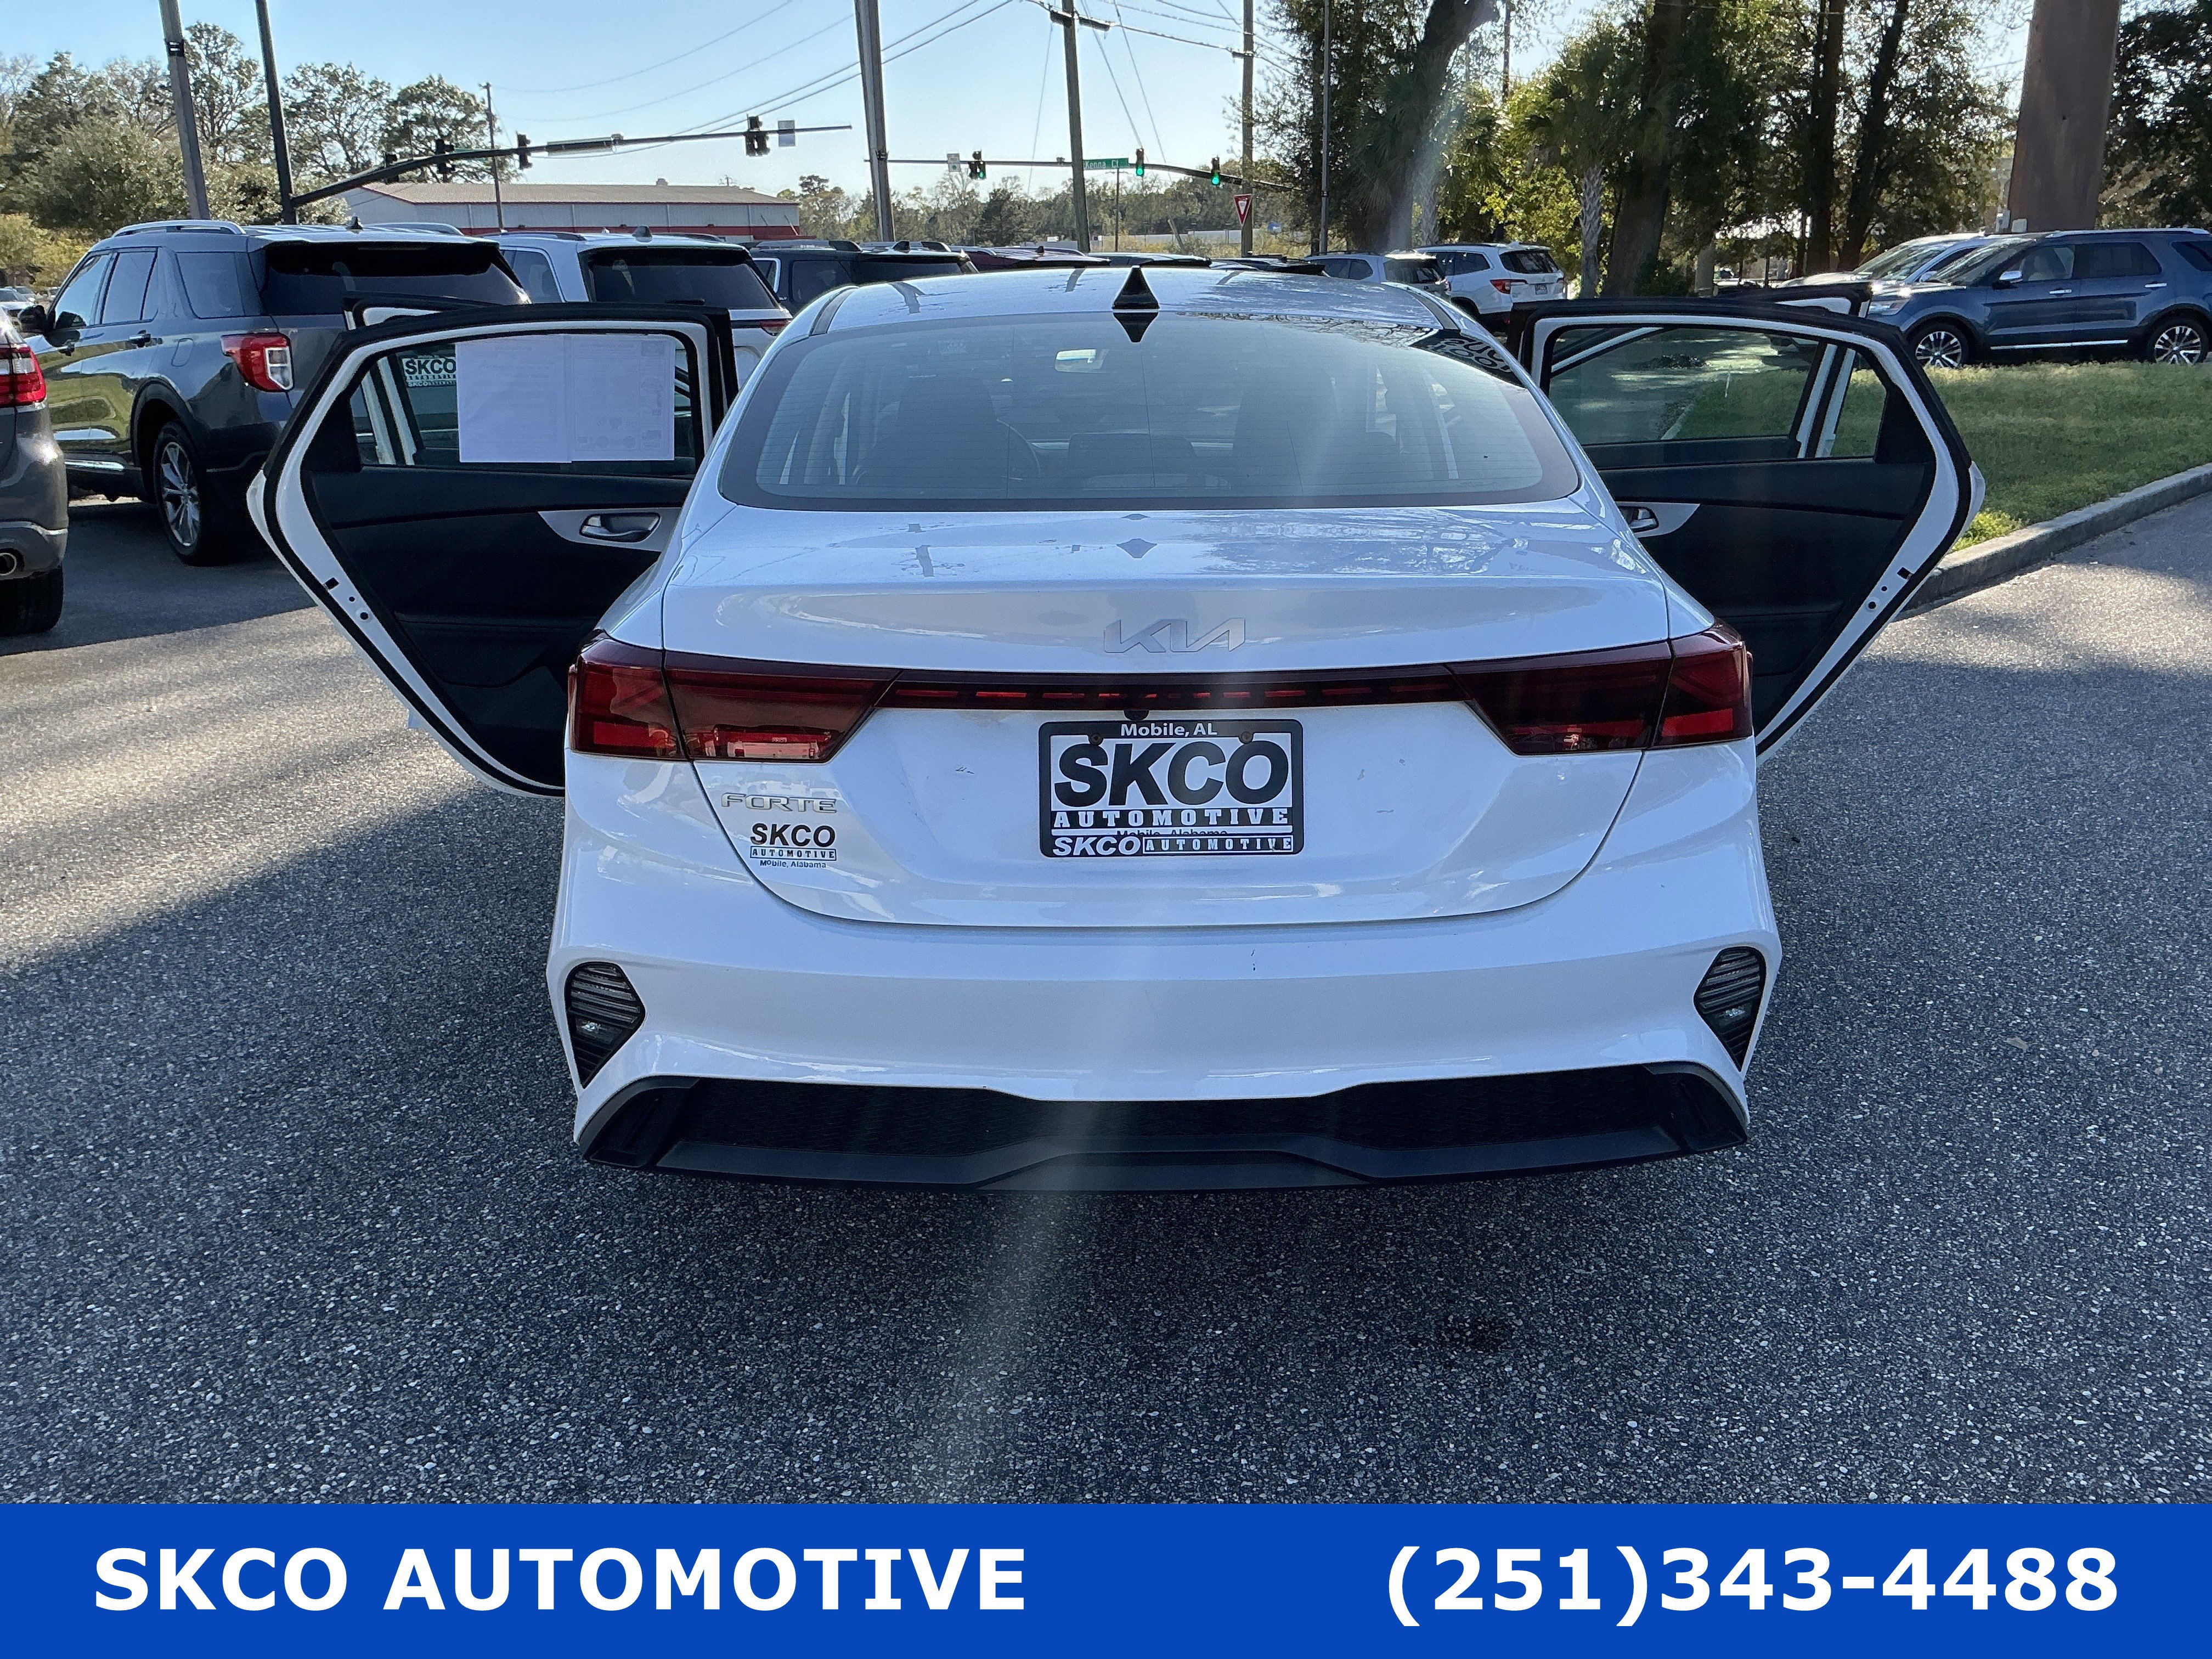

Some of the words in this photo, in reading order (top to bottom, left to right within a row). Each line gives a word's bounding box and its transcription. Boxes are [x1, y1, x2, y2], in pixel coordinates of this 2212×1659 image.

[1083, 161, 1107, 169] Kenna
[405, 359, 456, 375] SKCO
[1104, 617, 1246, 653] KIA
[1121, 723, 1190, 737] Mobile,
[1193, 723, 1218, 736] AL
[1054, 740, 1289, 808] SKCO
[721, 792, 837, 814] FORTE
[1053, 808, 1288, 827] AUTOMOTIVE
[750, 823, 836, 847] SKCO
[1052, 836, 1141, 856] SKCO
[1146, 838, 1291, 851] AUTOMOTIVE
[752, 849, 835, 859] AUTOMOTIVE
[760, 860, 788, 868] Mobile,
[791, 860, 826, 868] Alabama
